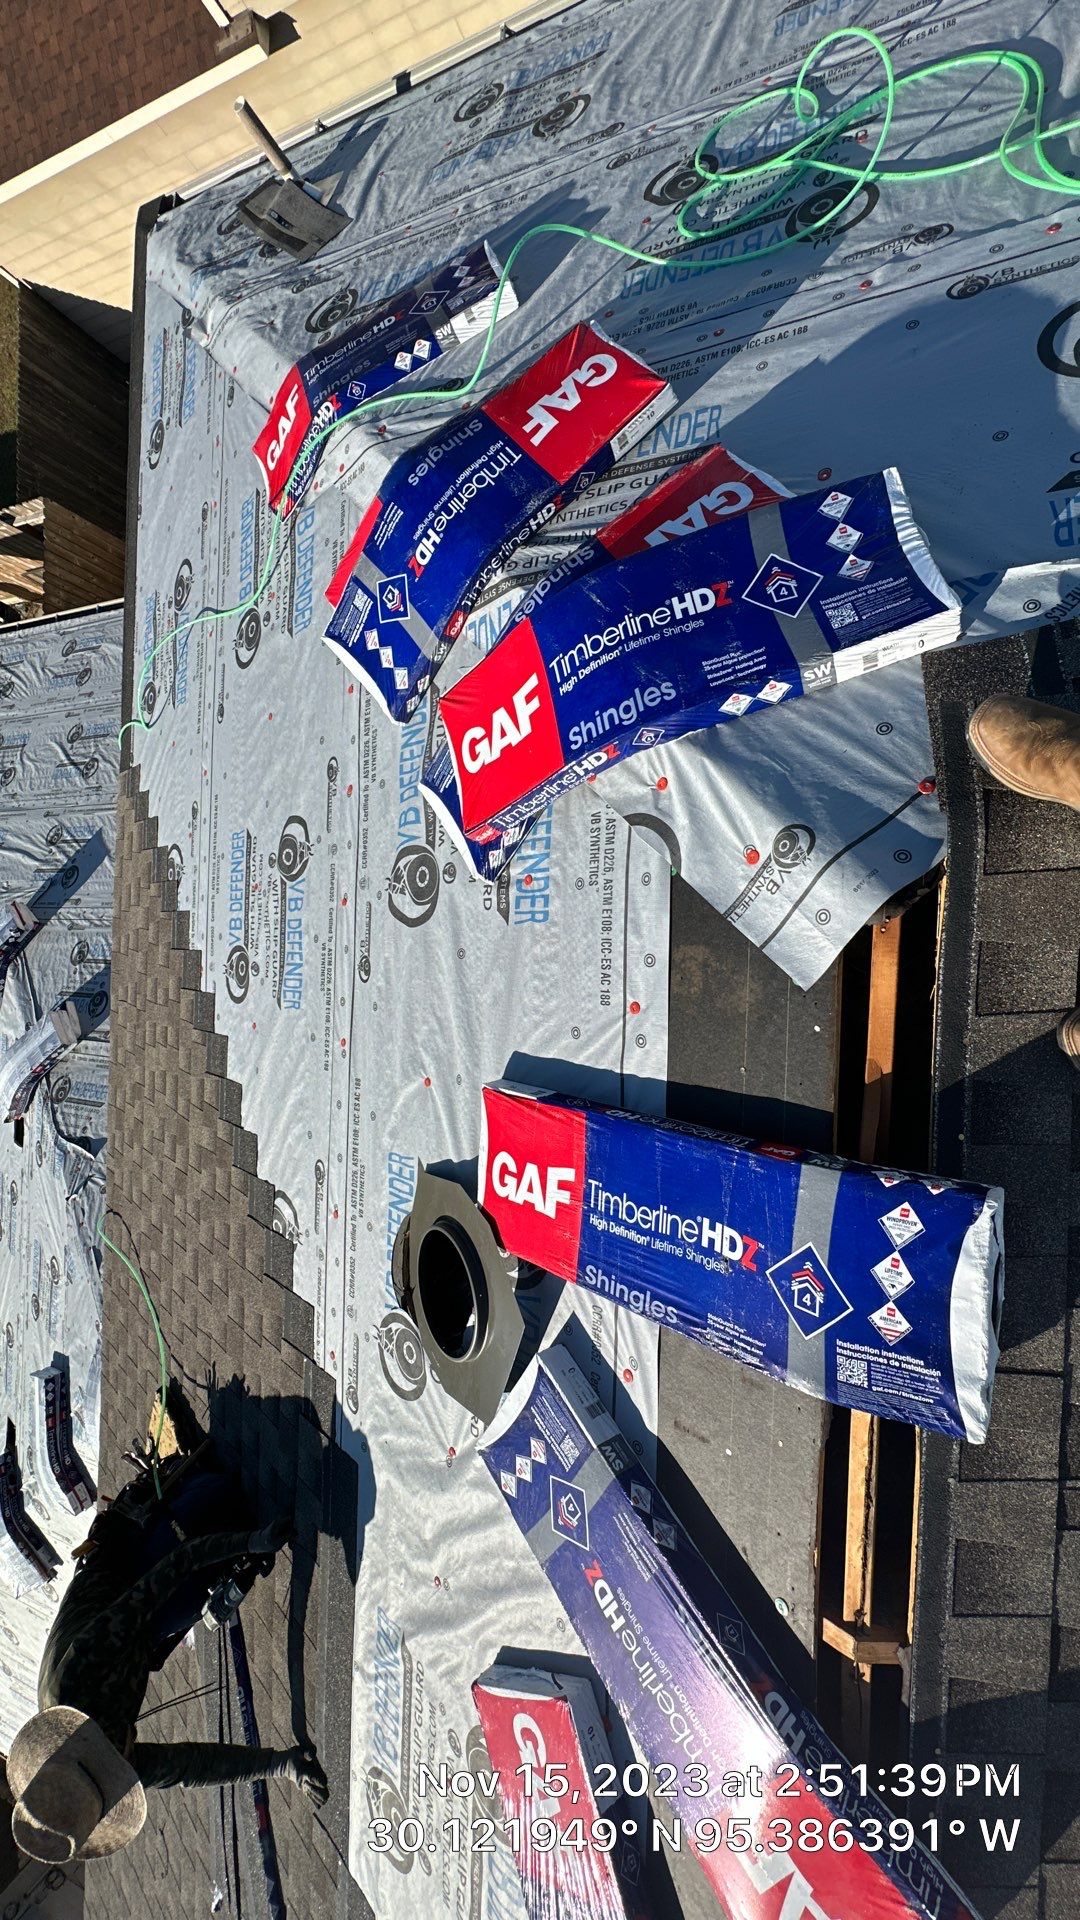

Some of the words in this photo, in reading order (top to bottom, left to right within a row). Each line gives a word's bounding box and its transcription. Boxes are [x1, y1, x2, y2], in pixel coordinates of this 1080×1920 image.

[435, 323, 452, 340] SW
[693, 351, 719, 365] ASTM
[746, 334, 776, 351] ICC-ES
[777, 331, 790, 343] AC
[791, 325, 809, 339] 188
[521, 352, 618, 447] GAF
[266, 383, 299, 471] GAF
[407, 418, 484, 487] Shingles
[485, 439, 504, 457] High
[609, 462, 656, 478] DEFENSE
[584, 481, 625, 501] SLIP
[412, 509, 436, 542] Shingles
[460, 525, 531, 608] Timberline
[294, 534, 316, 635] DEFENDER
[514, 542, 596, 624] Shingles
[779, 586, 789, 597] 4
[820, 587, 858, 605] Installation
[280, 585, 289, 634] GUARD
[558, 676, 579, 697] High
[623, 631, 661, 653] Lifetime
[662, 617, 705, 638] Shingles
[752, 654, 768, 665] Area
[803, 661, 833, 682] SW
[461, 672, 541, 774] GAF
[568, 680, 677, 751] Shingles
[362, 795, 370, 822] Certified
[493, 773, 577, 828] Timberline
[590, 811, 602, 826] VB
[604, 818, 617, 846] ASTM
[229, 828, 246, 913] DEFENDER
[602, 848, 616, 877] D226,
[287, 878, 306, 914] VB
[601, 878, 614, 906] ASTM
[764, 868, 792, 896] VB
[272, 880, 280, 915] WITH
[228, 916, 245, 946] VB
[249, 914, 257, 950] WITH
[272, 918, 280, 948] SLIP
[282, 918, 304, 1011] DEFENDER
[600, 937, 613, 971] ICC-ES
[271, 949, 279, 1000] GUARD
[600, 971, 612, 987] AC
[600, 988, 611, 1007] 188
[354, 1077, 362, 1090] 188
[354, 1090, 361, 1101] AC
[353, 1102, 361, 1127] ICC-ES
[351, 1145, 359, 1168] ASTM
[350, 1188, 358, 1210] ASTM
[491, 1150, 576, 1220] GAF
[350, 1211, 357, 1221] To
[349, 1220, 357, 1252] Certified
[589, 1213, 608, 1232] High
[650, 1237, 684, 1259] Lifetime
[685, 1247, 726, 1275] Shingles
[884, 1267, 903, 1278] LIFETIME
[584, 1264, 679, 1325] Shingles
[801, 1292, 812, 1306] 4
[836, 1339, 880, 1356] Installation
[836, 1346, 888, 1366] Instrucciones
[889, 1359, 900, 1368] de
[871, 1385, 935, 1405] gaf.com/StrikeZone
[600, 1444, 625, 1473] SW
[616, 1586, 643, 1636] Shingles
[641, 1634, 674, 1682] Lifetime
[413, 1660, 425, 1730] GUARD
